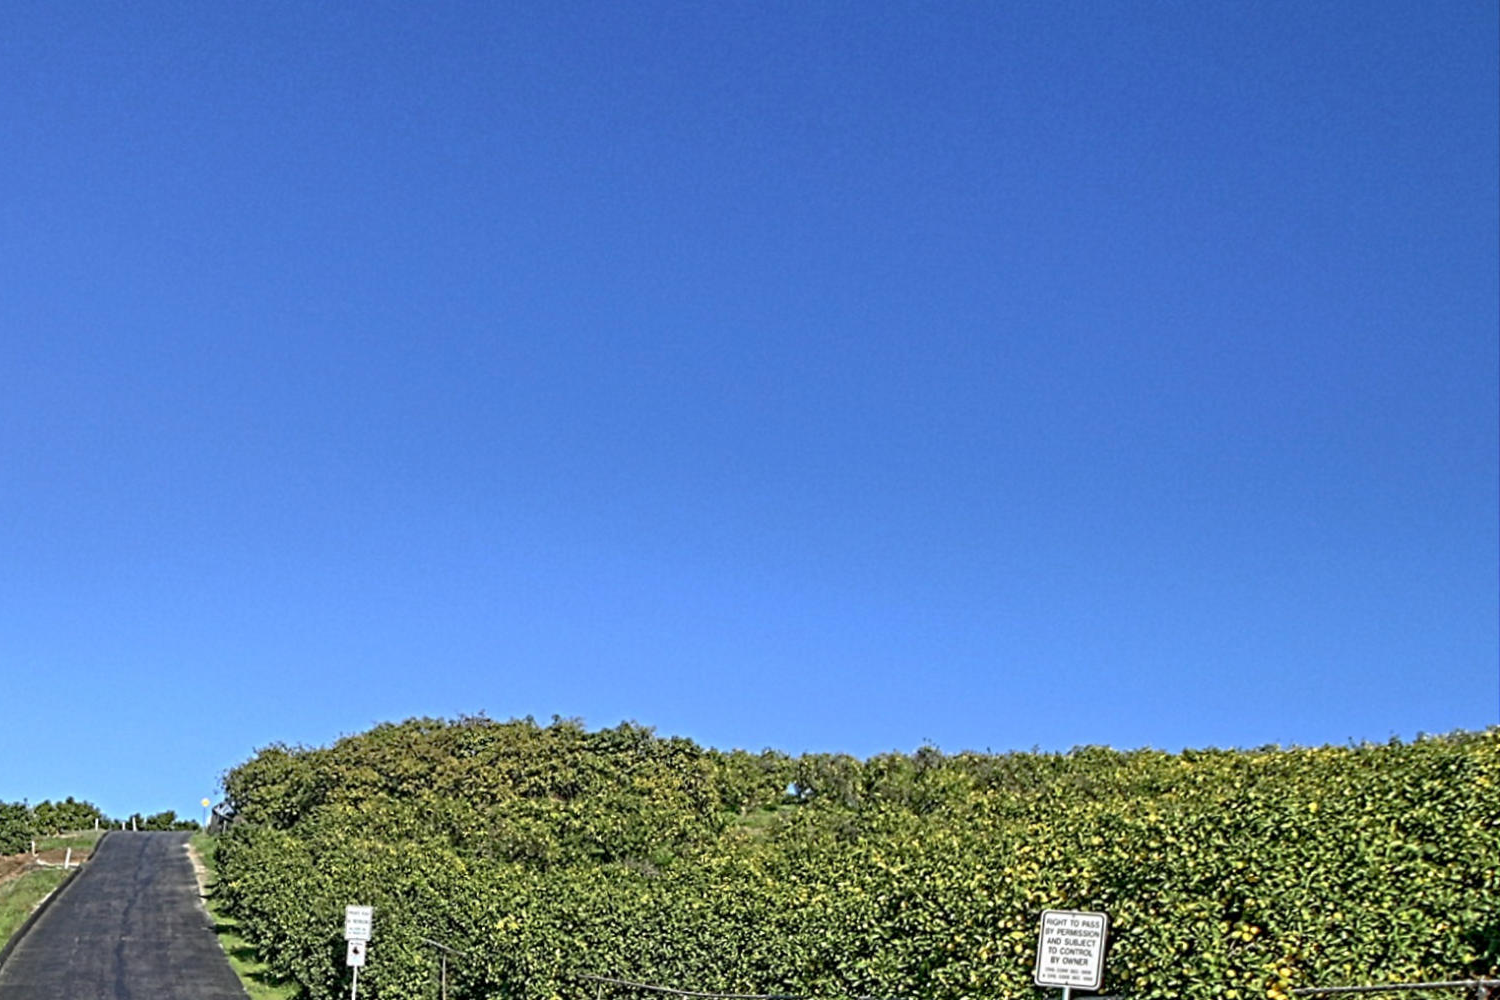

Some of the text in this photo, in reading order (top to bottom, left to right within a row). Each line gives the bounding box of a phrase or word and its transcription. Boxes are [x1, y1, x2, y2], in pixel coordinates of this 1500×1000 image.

[1082, 920, 1100, 928] PASS
[1057, 928, 1100, 937] PERMISSION
[1064, 938, 1096, 947] SUBJECT
[1060, 947, 1092, 956] CONTROL
[1062, 957, 1088, 965] OWNER
